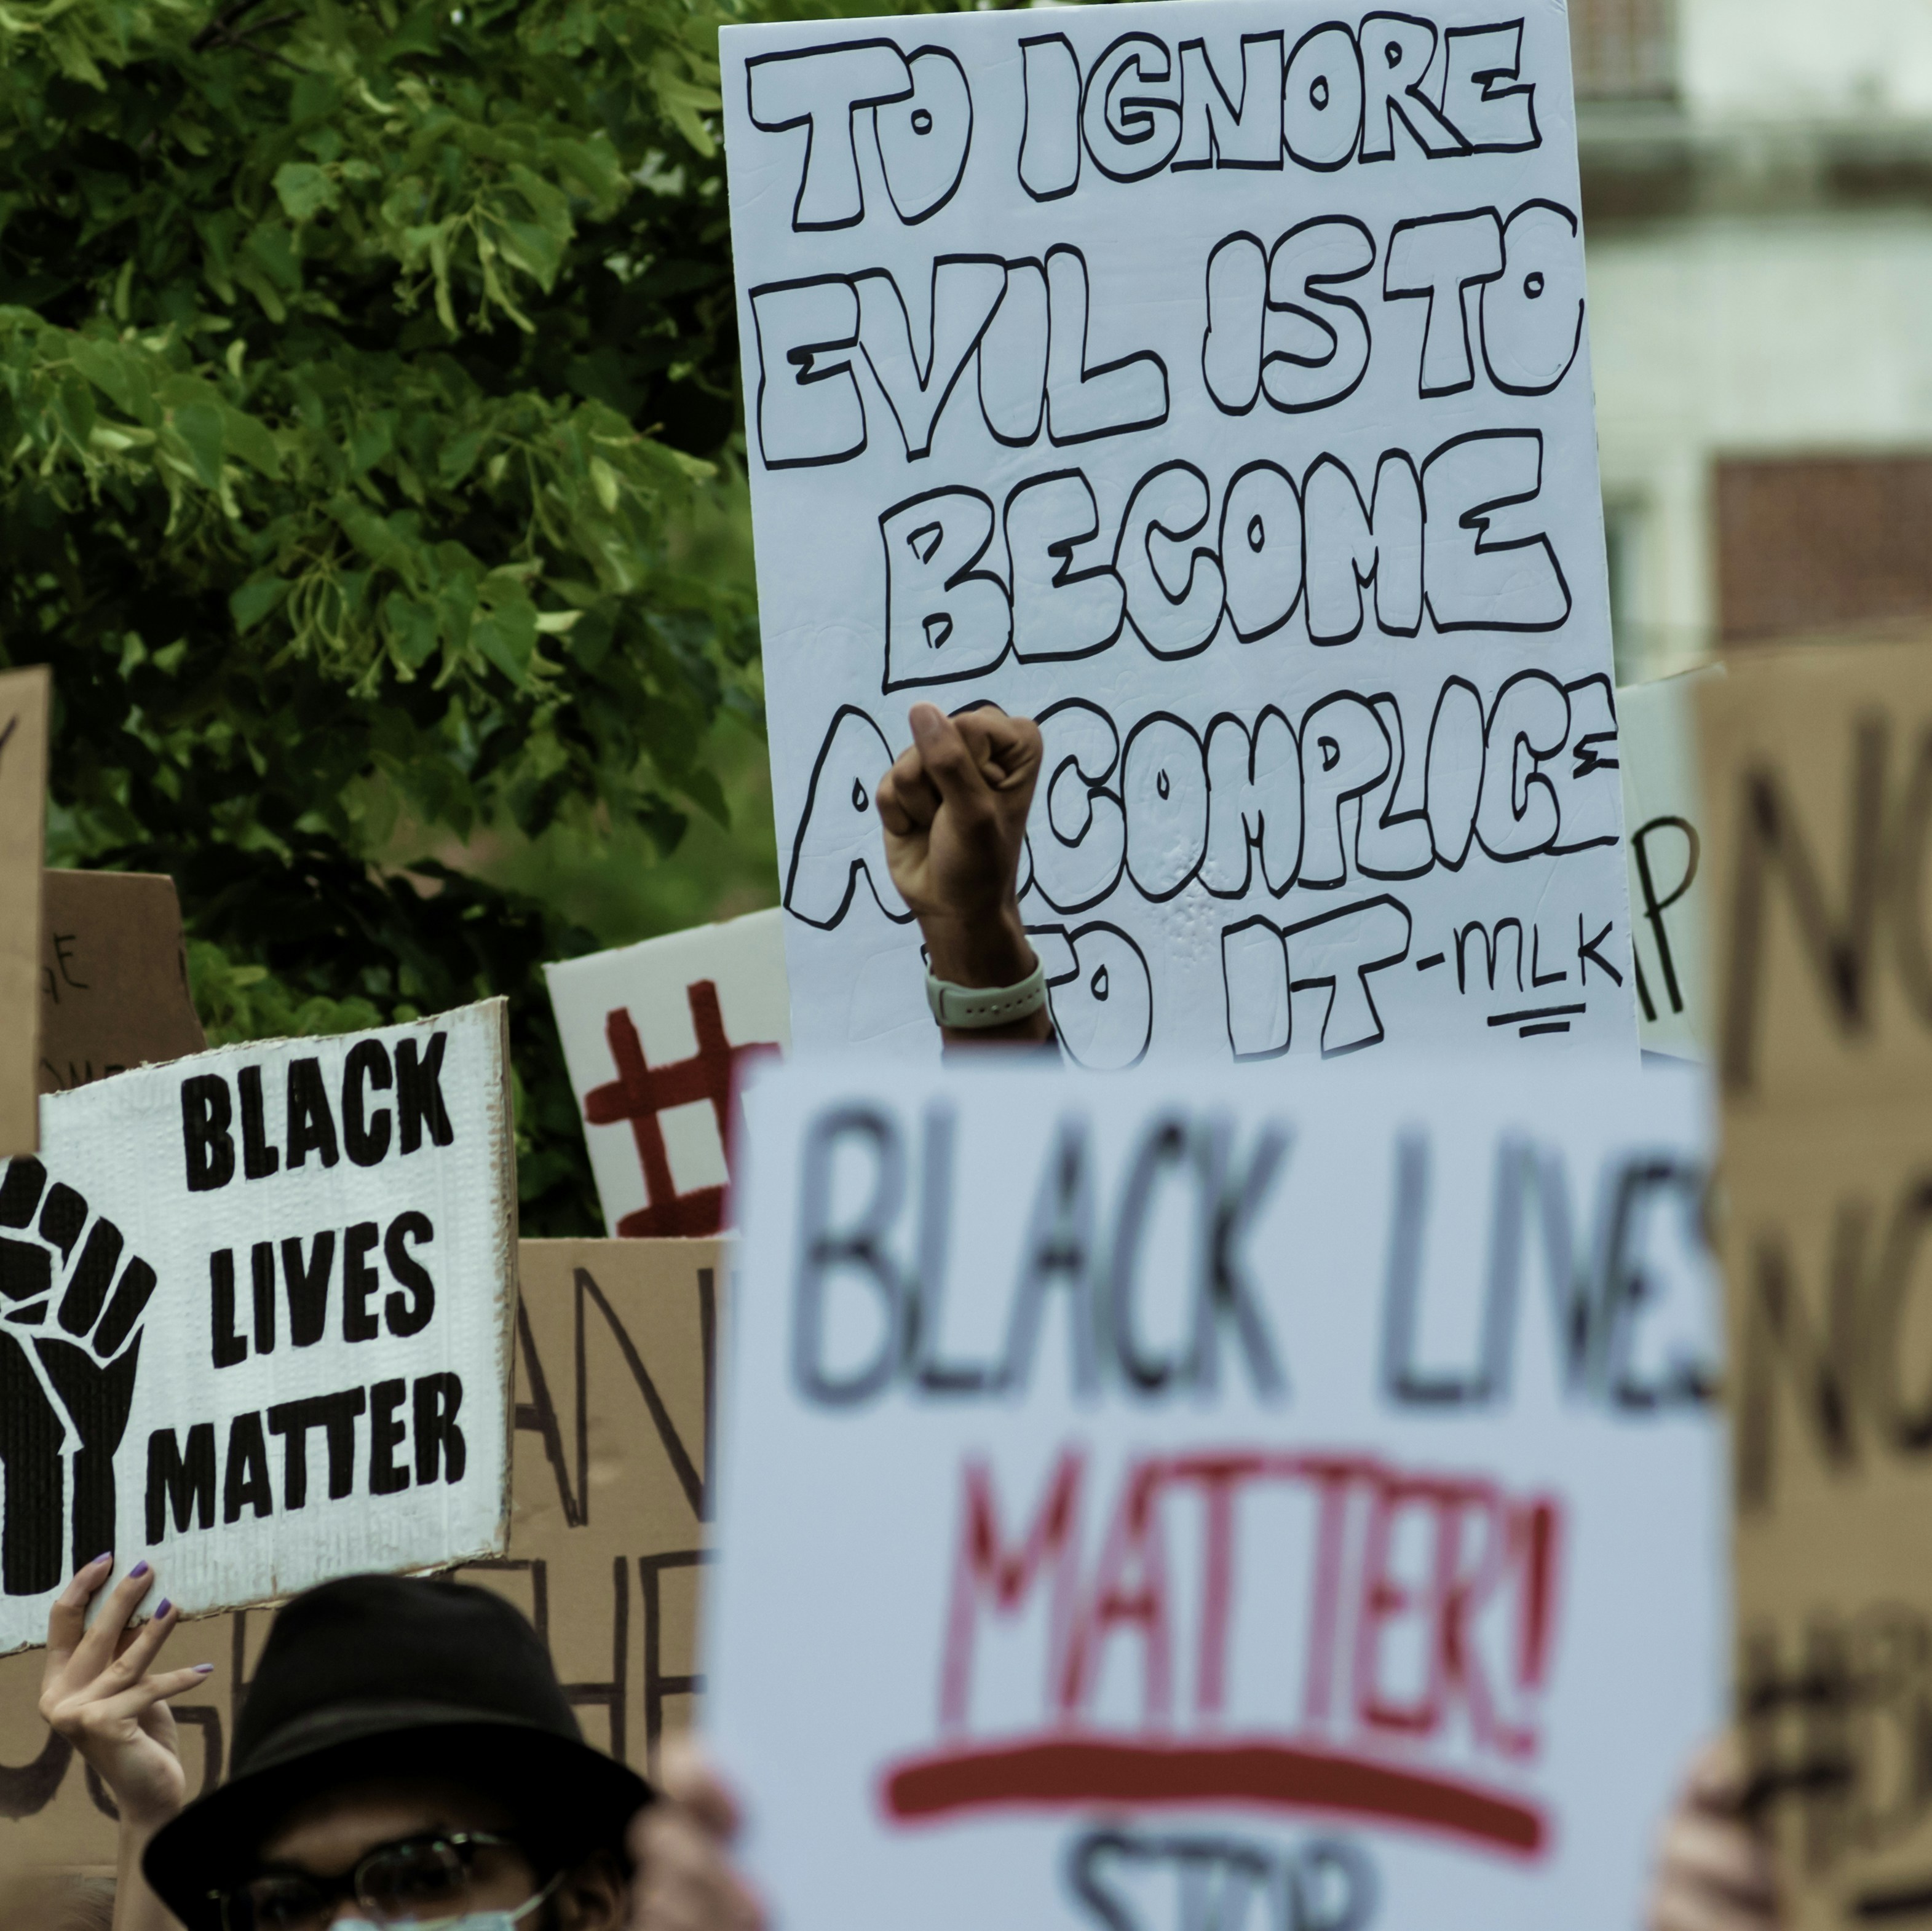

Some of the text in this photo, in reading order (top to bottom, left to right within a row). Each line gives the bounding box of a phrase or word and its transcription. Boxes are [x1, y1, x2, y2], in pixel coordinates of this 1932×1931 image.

[746, 11, 1541, 232] TO IGNORE
[748, 198, 1585, 470] EVIL IS TO
[878, 428, 1572, 695] BECOME
[784, 669, 1620, 931] ACOMPLICE
[181, 1032, 454, 1191] BLACK
[210, 1210, 435, 1369] LIVES
[790, 1094, 1299, 1416] BLACK
[145, 1371, 467, 1546] MATTER
[937, 1439, 1566, 1763] MATTER!
